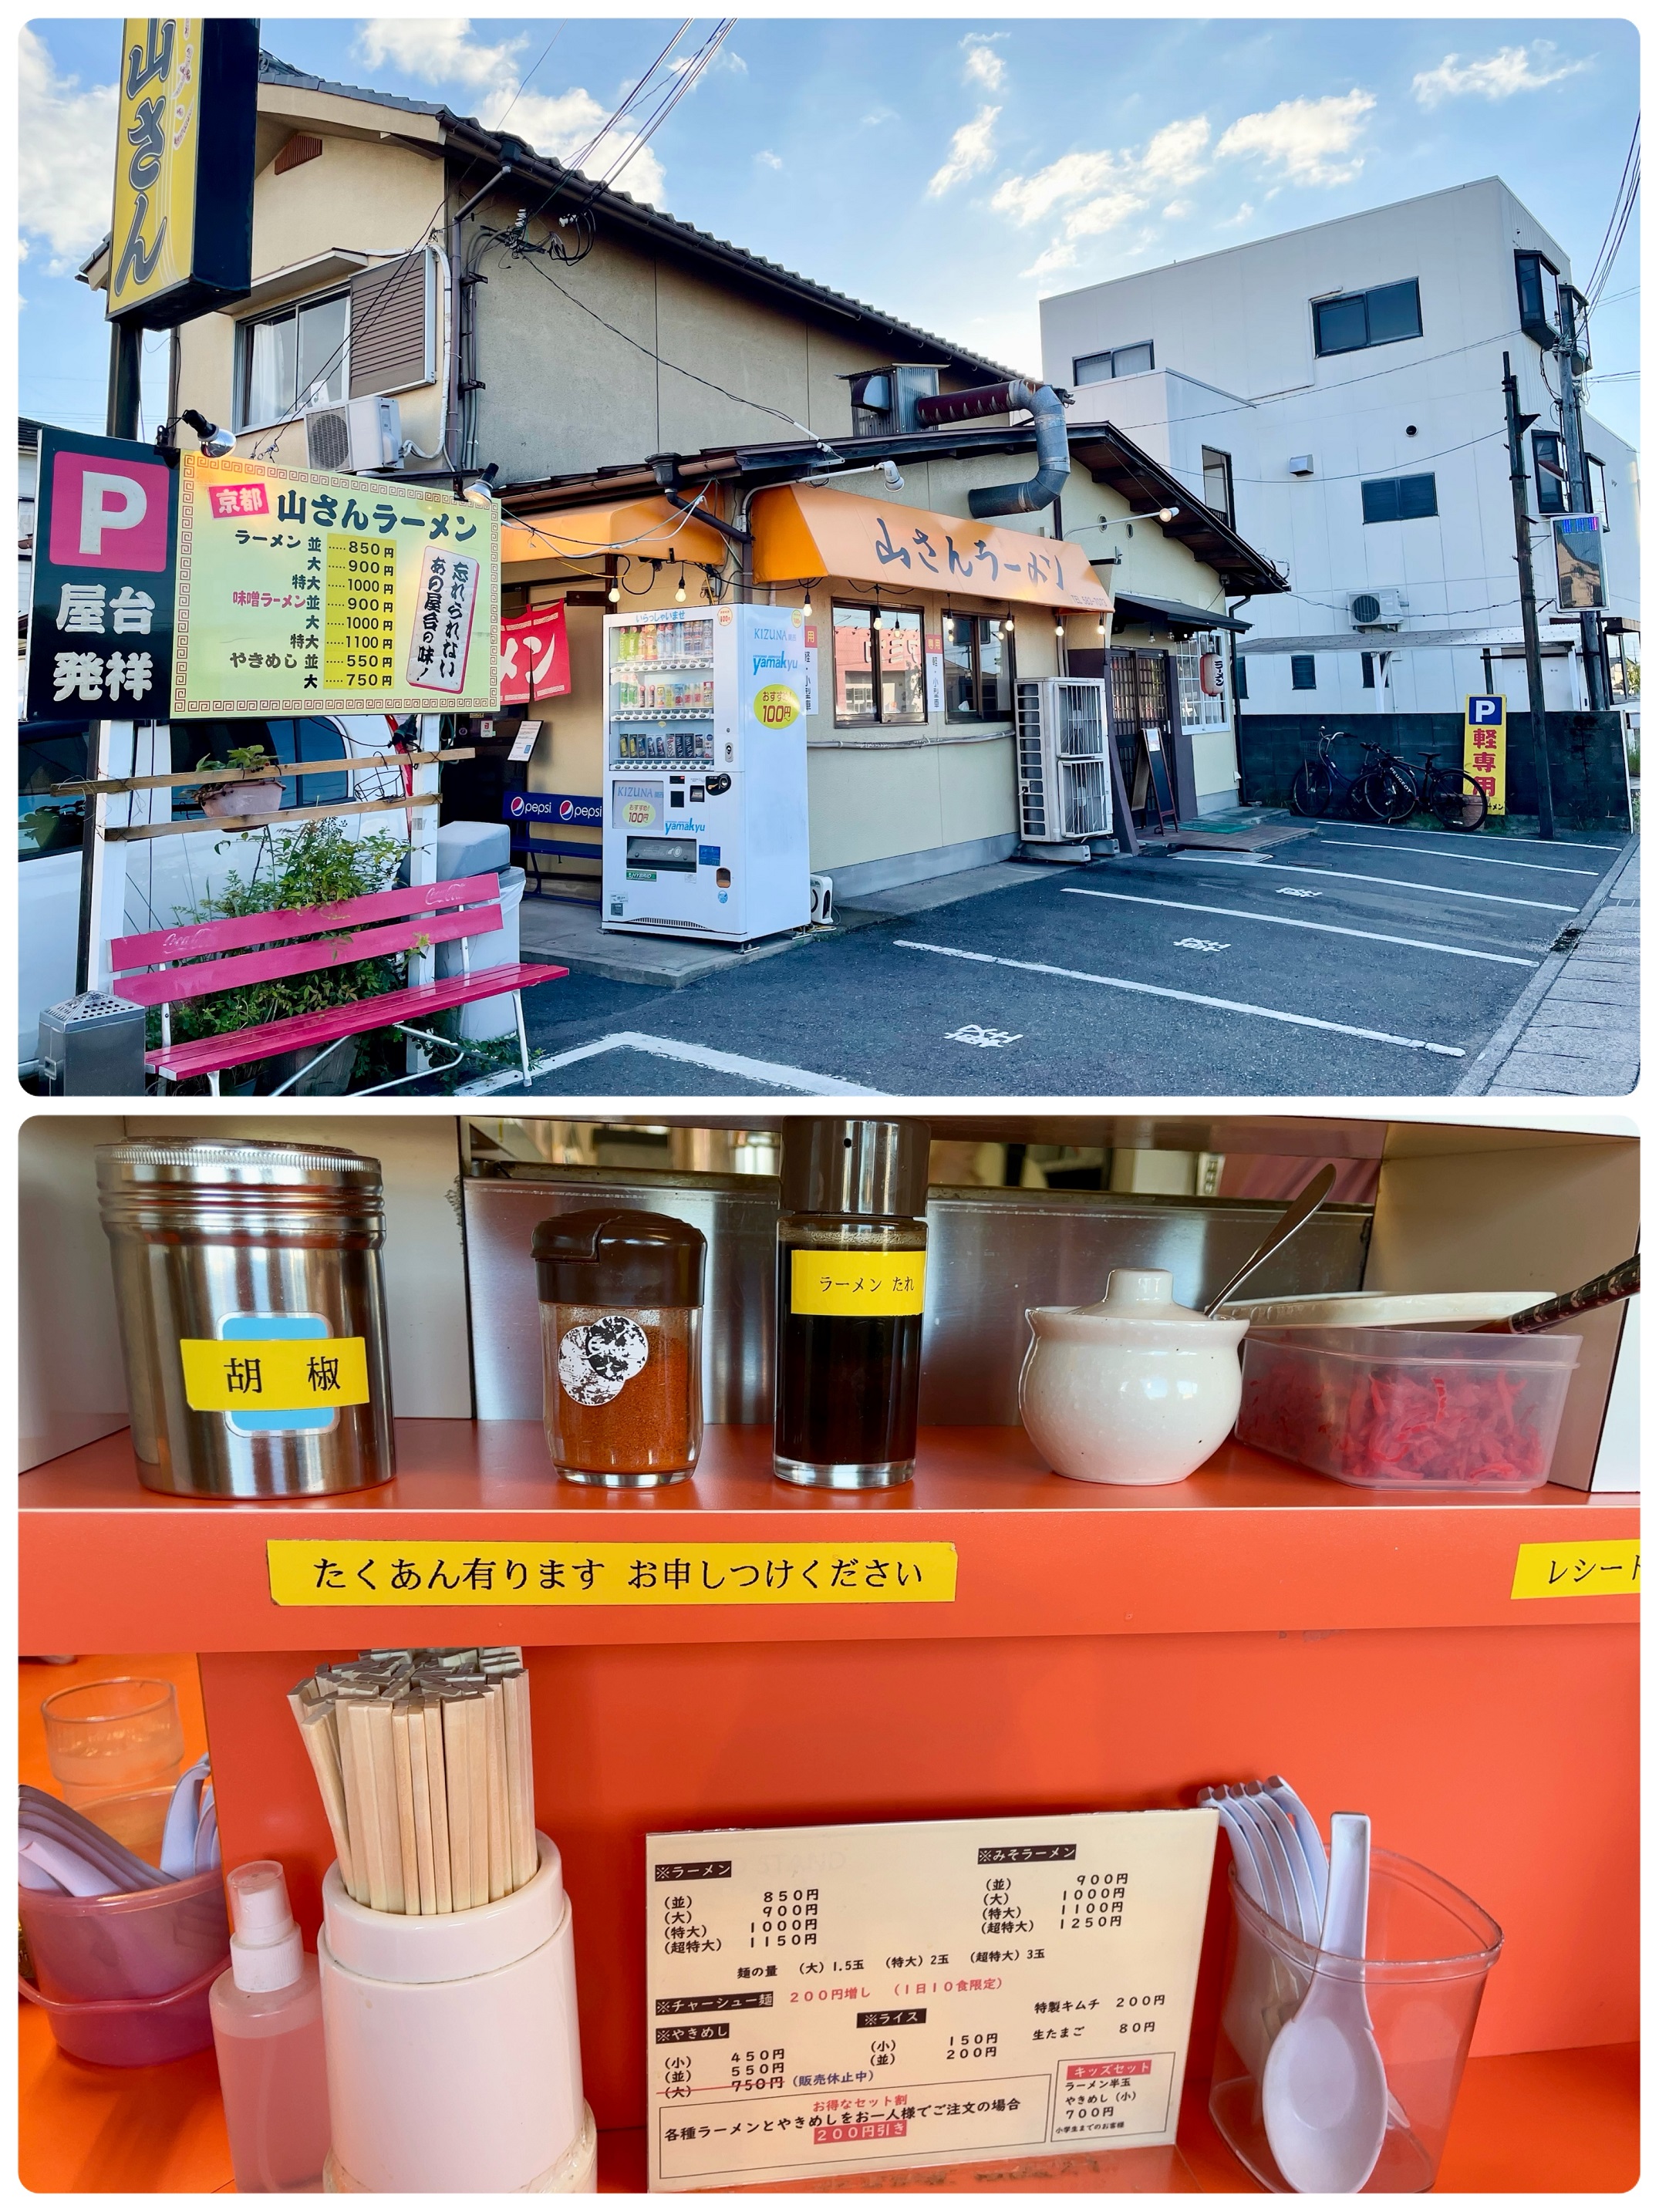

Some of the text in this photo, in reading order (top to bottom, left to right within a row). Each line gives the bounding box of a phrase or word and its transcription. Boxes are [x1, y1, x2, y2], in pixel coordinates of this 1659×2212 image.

[114, 19, 176, 297] 山さん
[79, 470, 147, 555] P
[216, 488, 477, 541] 京都 山さんラーメン
[234, 530, 393, 558] ラーメン 並 850円
[308, 557, 393, 576] 大 900円
[292, 574, 393, 595] 特大 1000円
[56, 583, 155, 635] 屋台
[233, 591, 306, 609] 味噌ラーメン
[347, 598, 393, 612] 900円
[305, 615, 393, 631] 大 1000円
[440, 561, 470, 678] 忘れられない
[636, 610, 686, 622] いらっしゃいませ
[290, 634, 393, 651] 特大 1100円
[754, 629, 787, 641] KIZUNA
[230, 653, 393, 669] やきめし 並 550円
[753, 651, 797, 676] yamakyu
[53, 652, 153, 701] 発祥
[304, 674, 392, 689] 大 750円
[1213, 660, 1224, 687] ラーメン
[1475, 700, 1495, 722] P
[1472, 728, 1497, 797] 軽専用
[1390, 767, 1411, 793] PEUGEOT
[617, 786, 653, 798] KIZUNA
[524, 800, 551, 814] pepsi
[574, 804, 602, 819] pepsi
[665, 818, 706, 835] yamakyu
[820, 1276, 915, 1293] ラーメン たれ
[312, 1556, 924, 1593] たくあん有ります お申しつけください
[986, 1873, 1128, 1891] (並) 900円
[664, 1889, 819, 1910] (並) 850円
[983, 1887, 1125, 1906] (大) 1000円
[664, 1903, 818, 1925] (大) 900円
[982, 1901, 1124, 1920] (特大) 1100円
[664, 1918, 818, 1940] (特大) 1000円
[981, 1915, 1122, 1934] (超特大) 1250円
[664, 1933, 817, 1954] (超特大) 1150円
[737, 1964, 778, 1979] 麺の量
[790, 1986, 871, 2004] 200円増し
[894, 1977, 1003, 1997] (1日10食限定)
[1034, 1994, 1165, 2015] 特製キムチ 200円
[1032, 2021, 1156, 2041] 生たまご 80円
[870, 2032, 998, 2053] (小) 150円
[664, 2048, 785, 2069] (小) 450円
[870, 2045, 996, 2066] (並) 200円
[664, 2062, 785, 2084] (並) 550円
[1074, 2061, 1149, 2078] キッズセット
[664, 2069, 875, 2099] (大) 750円 (販売休止中)
[1065, 2077, 1131, 2092] ラーメン半玉
[812, 2093, 909, 2113] お得なセット割
[1066, 2106, 1114, 2120] 700円
[664, 2097, 1021, 2143] 各種ラーメンとやきめしをお一人様でご注文の場合
[1055, 2121, 1125, 2134] 小学生までのお客様
[816, 2123, 905, 2143] 200円引き
